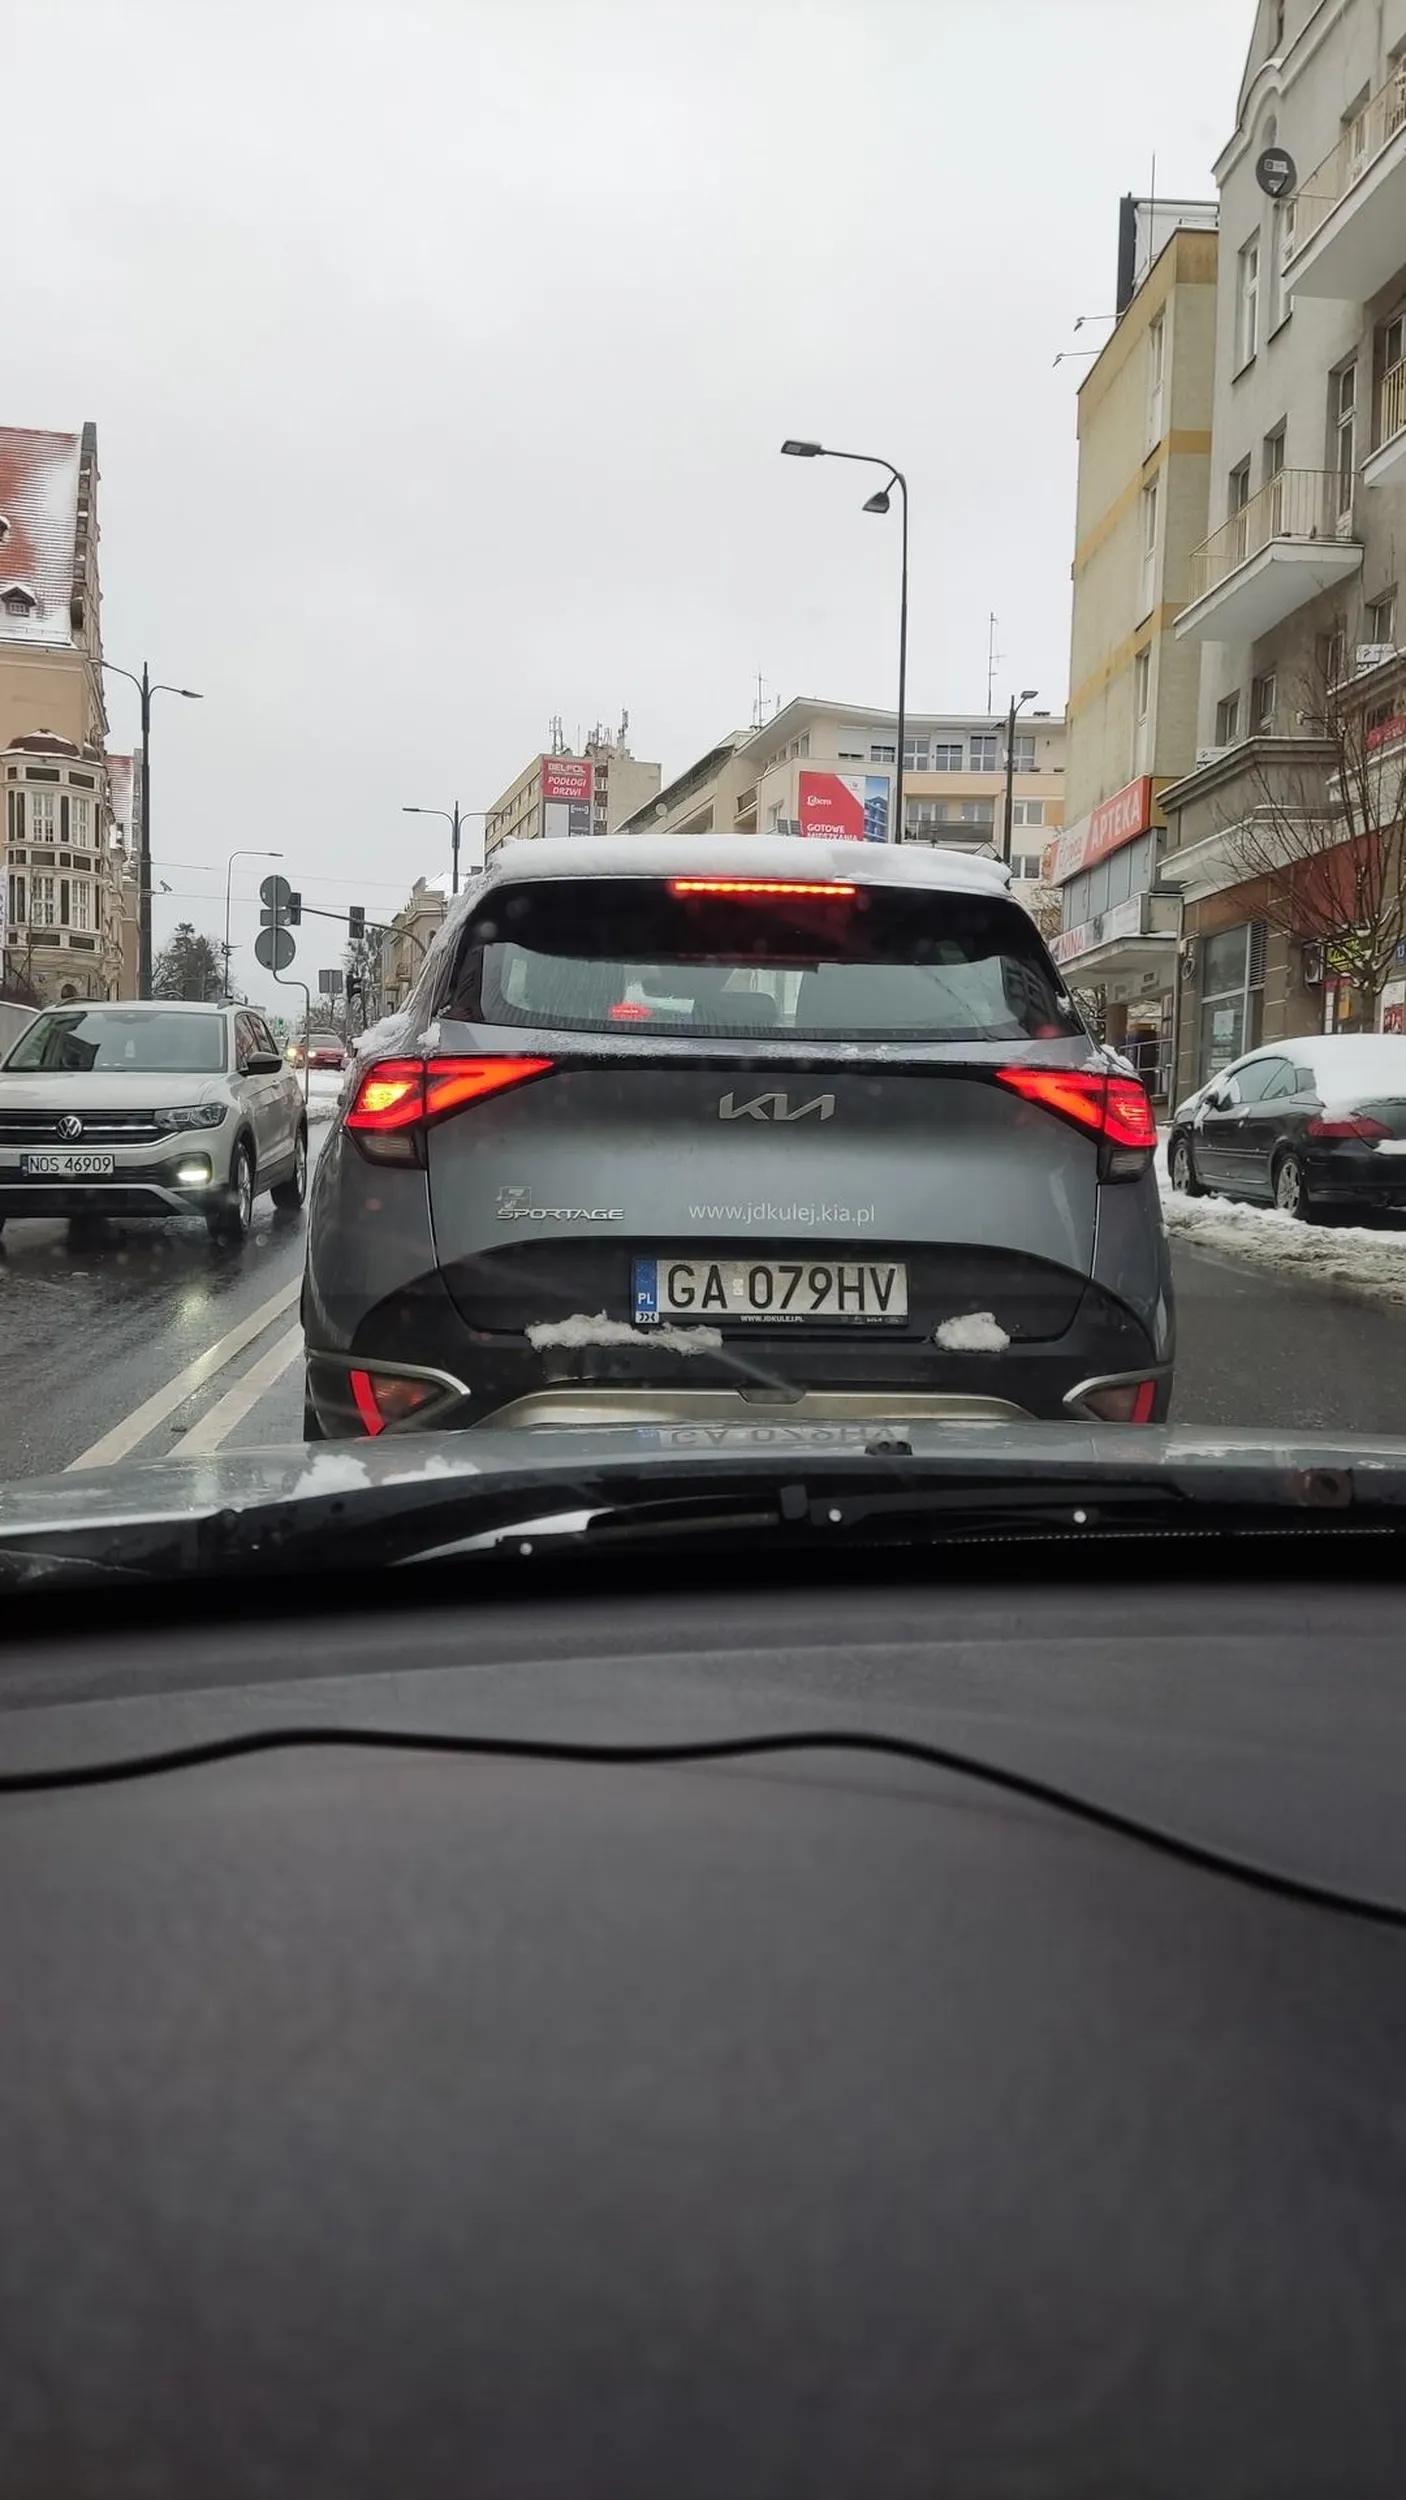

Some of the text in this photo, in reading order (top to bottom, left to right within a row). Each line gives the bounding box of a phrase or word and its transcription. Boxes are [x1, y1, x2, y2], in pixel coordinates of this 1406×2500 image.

[547, 776, 587, 788] PODŁOGI
[552, 787, 582, 796] DRZWI
[1090, 790, 1140, 853] APTEKA
[29, 1157, 112, 1172] NOS 46909
[496, 1208, 624, 1220] SPORTAGE
[688, 1203, 876, 1226] www.jdkulej.kia.pl
[667, 1264, 896, 1312] GA 079HV
[638, 1292, 654, 1305] PL
